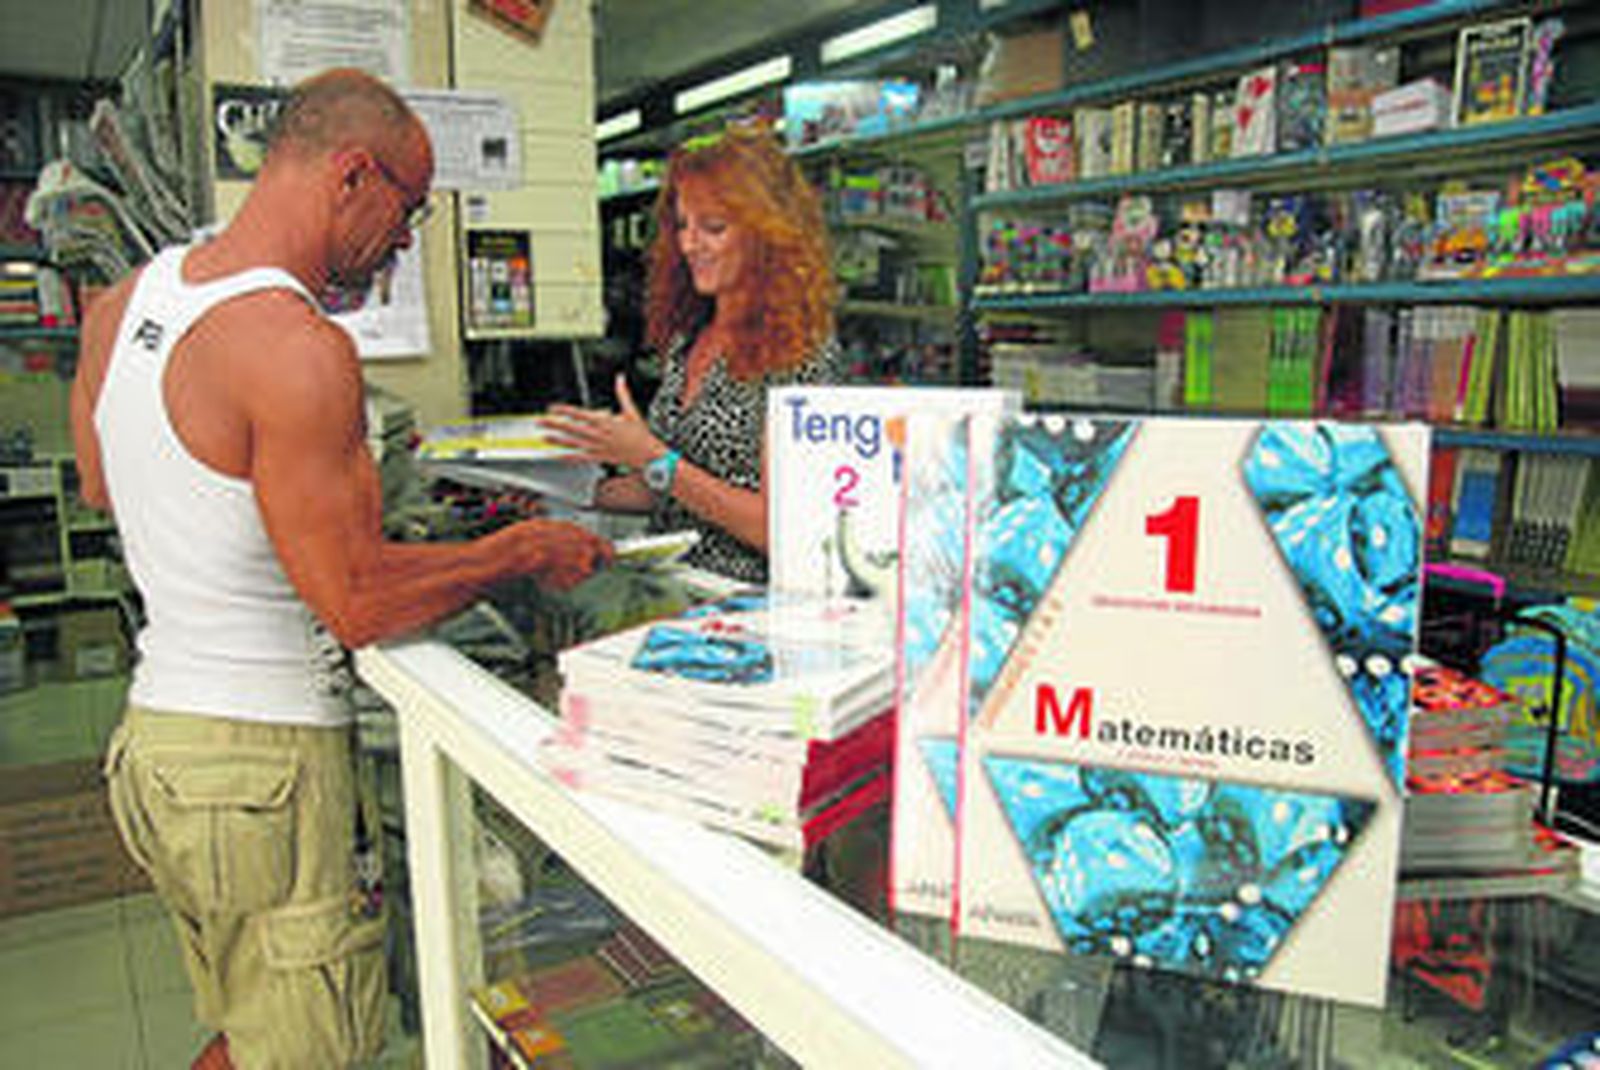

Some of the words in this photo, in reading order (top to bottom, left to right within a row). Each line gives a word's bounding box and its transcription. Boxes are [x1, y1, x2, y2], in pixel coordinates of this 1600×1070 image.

[833, 465, 861, 507] 2
[1144, 495, 1200, 594] 1
[1034, 683, 1316, 766] Matemáticas
